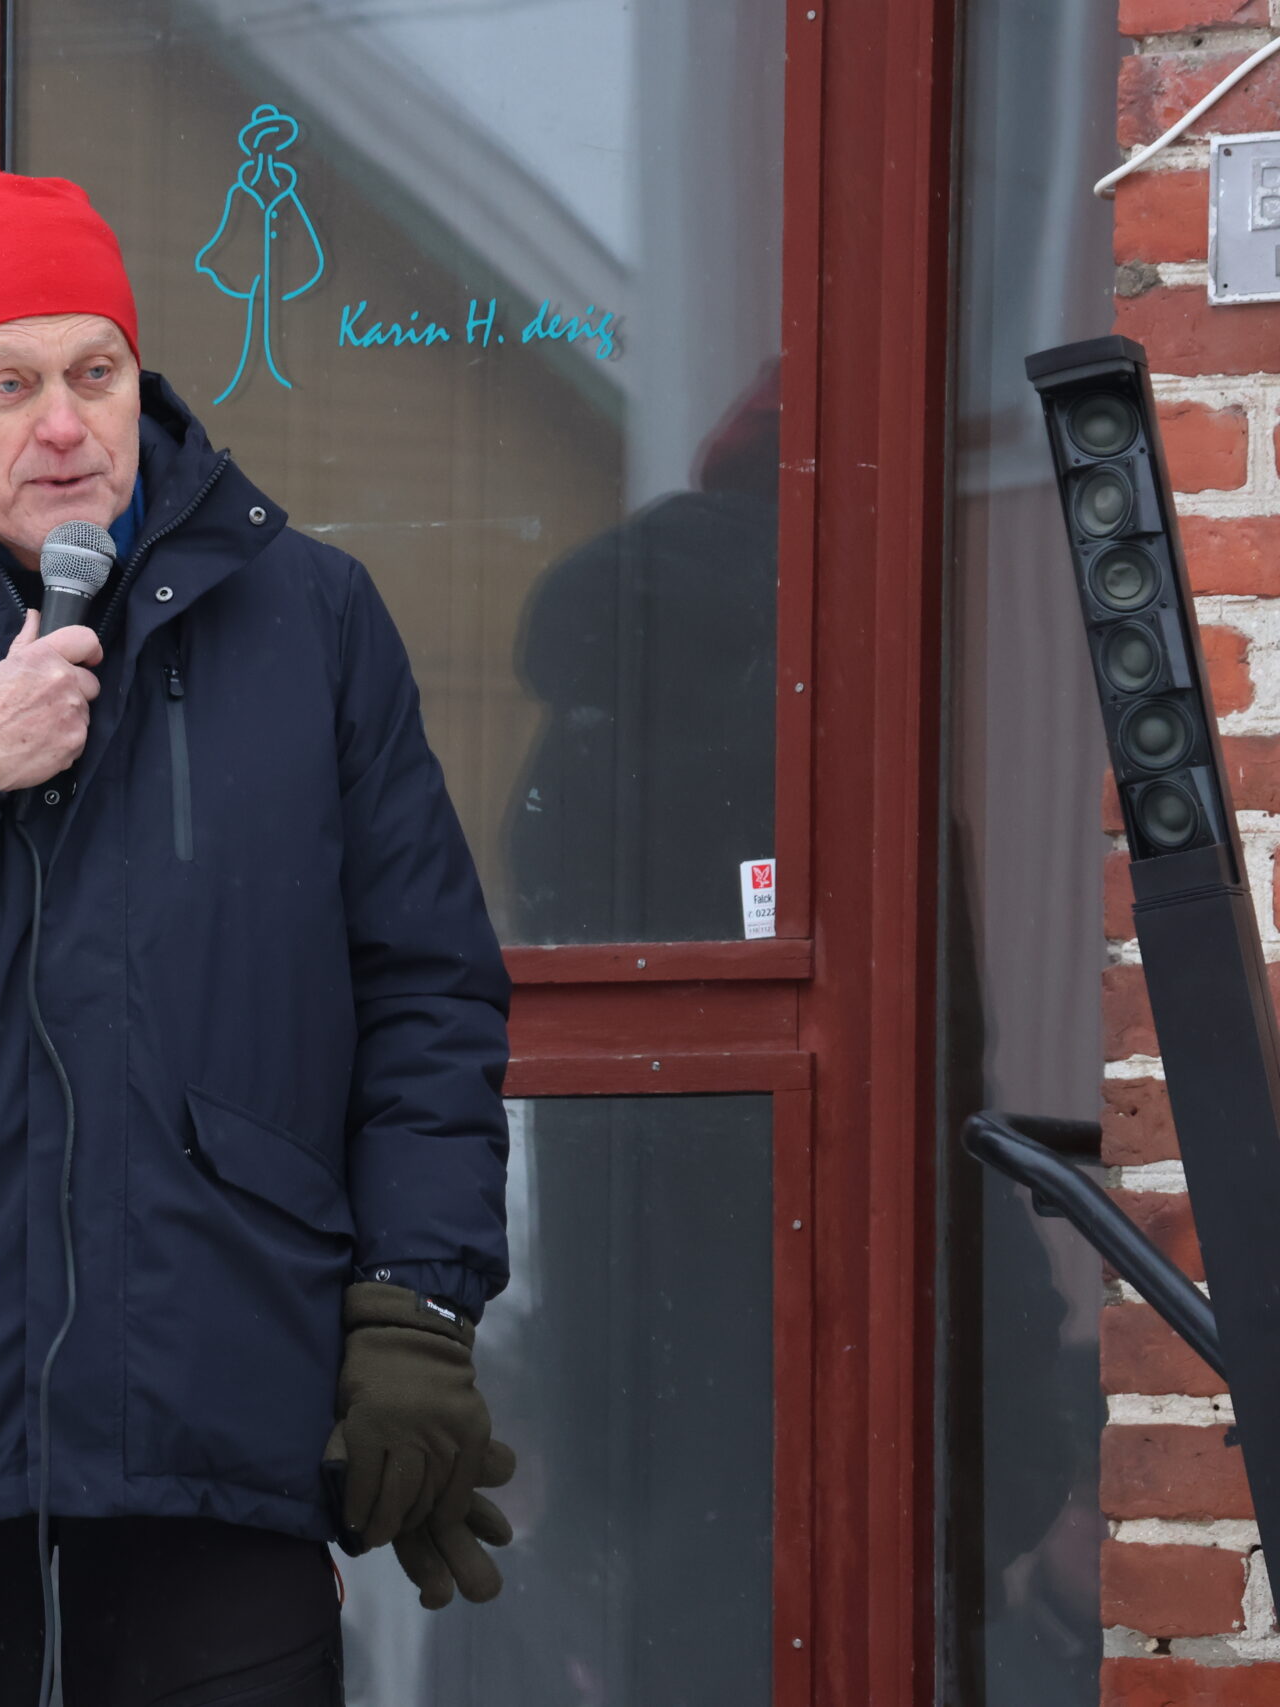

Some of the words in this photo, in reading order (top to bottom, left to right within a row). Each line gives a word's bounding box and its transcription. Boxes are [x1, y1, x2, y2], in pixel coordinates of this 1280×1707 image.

[339, 300, 451, 348] Karin
[466, 298, 505, 348] H.
[522, 298, 614, 360] desig
[754, 894, 773, 905] Falck
